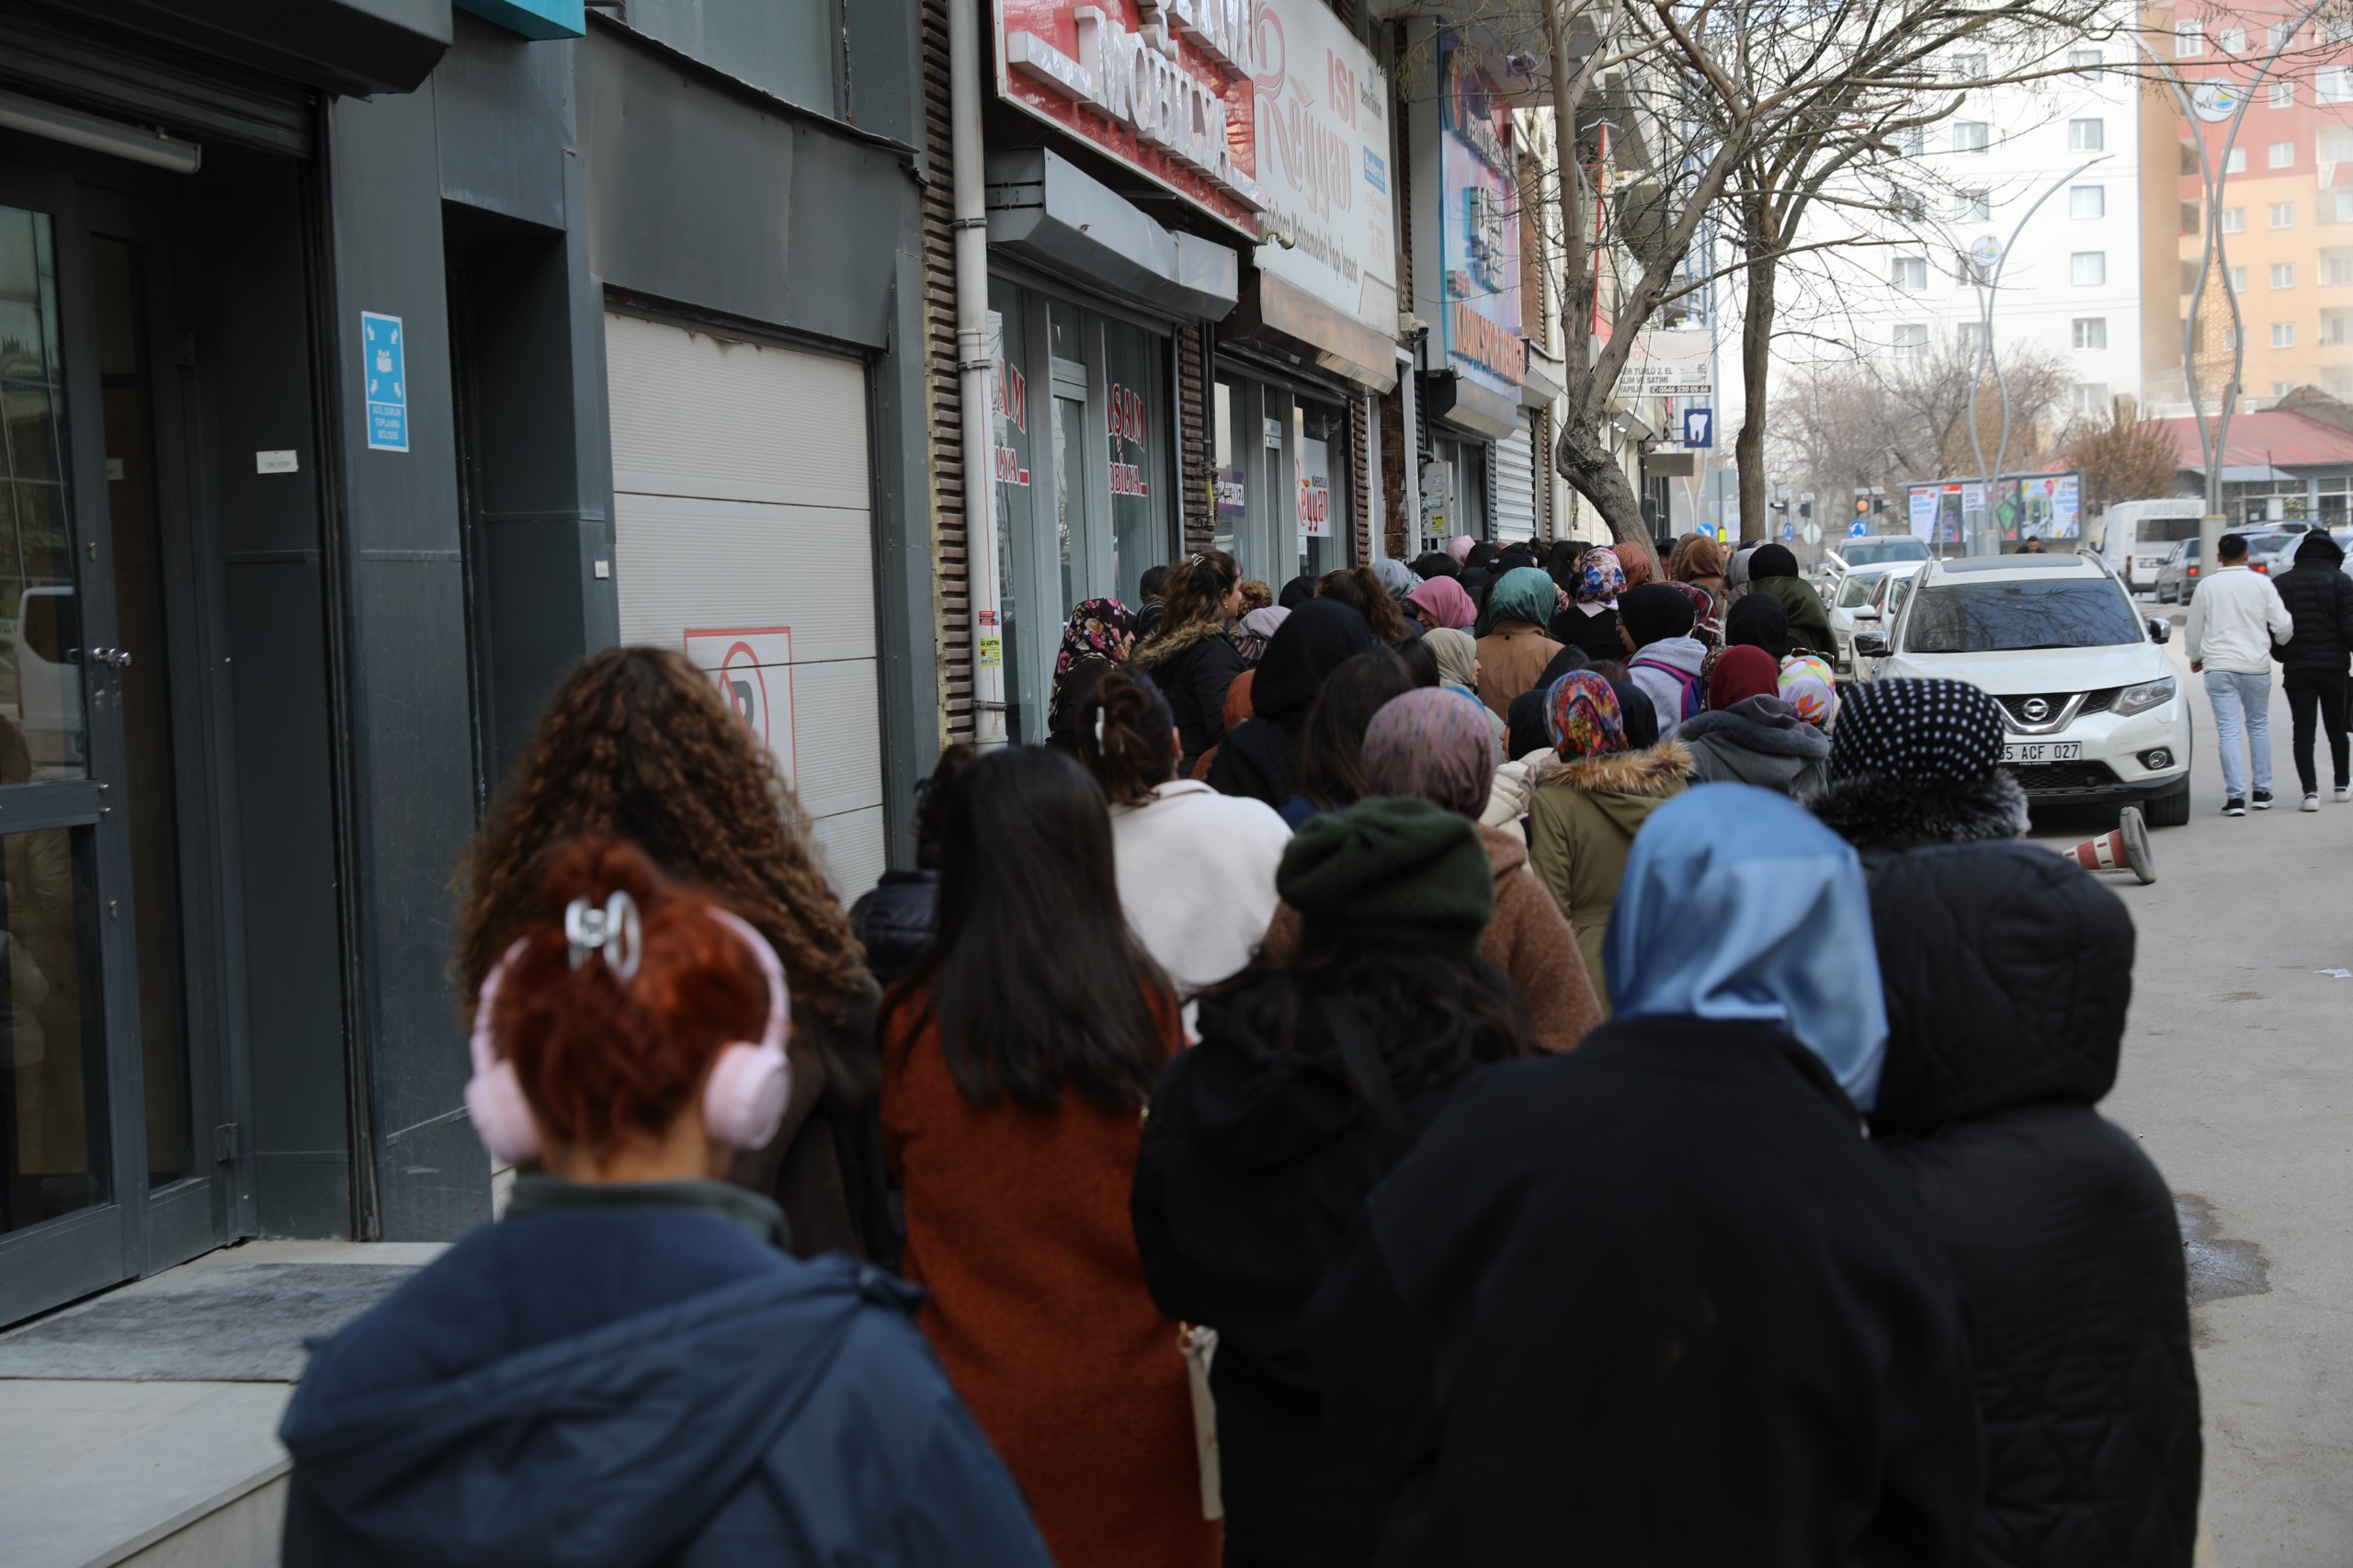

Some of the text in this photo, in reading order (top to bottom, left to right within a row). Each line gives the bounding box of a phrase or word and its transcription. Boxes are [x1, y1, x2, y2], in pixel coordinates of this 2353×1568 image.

[1326, 45, 1357, 131] ISI
[1455, 301, 1481, 361] KADIN
[1481, 315, 1499, 373] SPOR
[2021, 745, 2045, 760] ACF
[2054, 744, 2079, 759] 027
